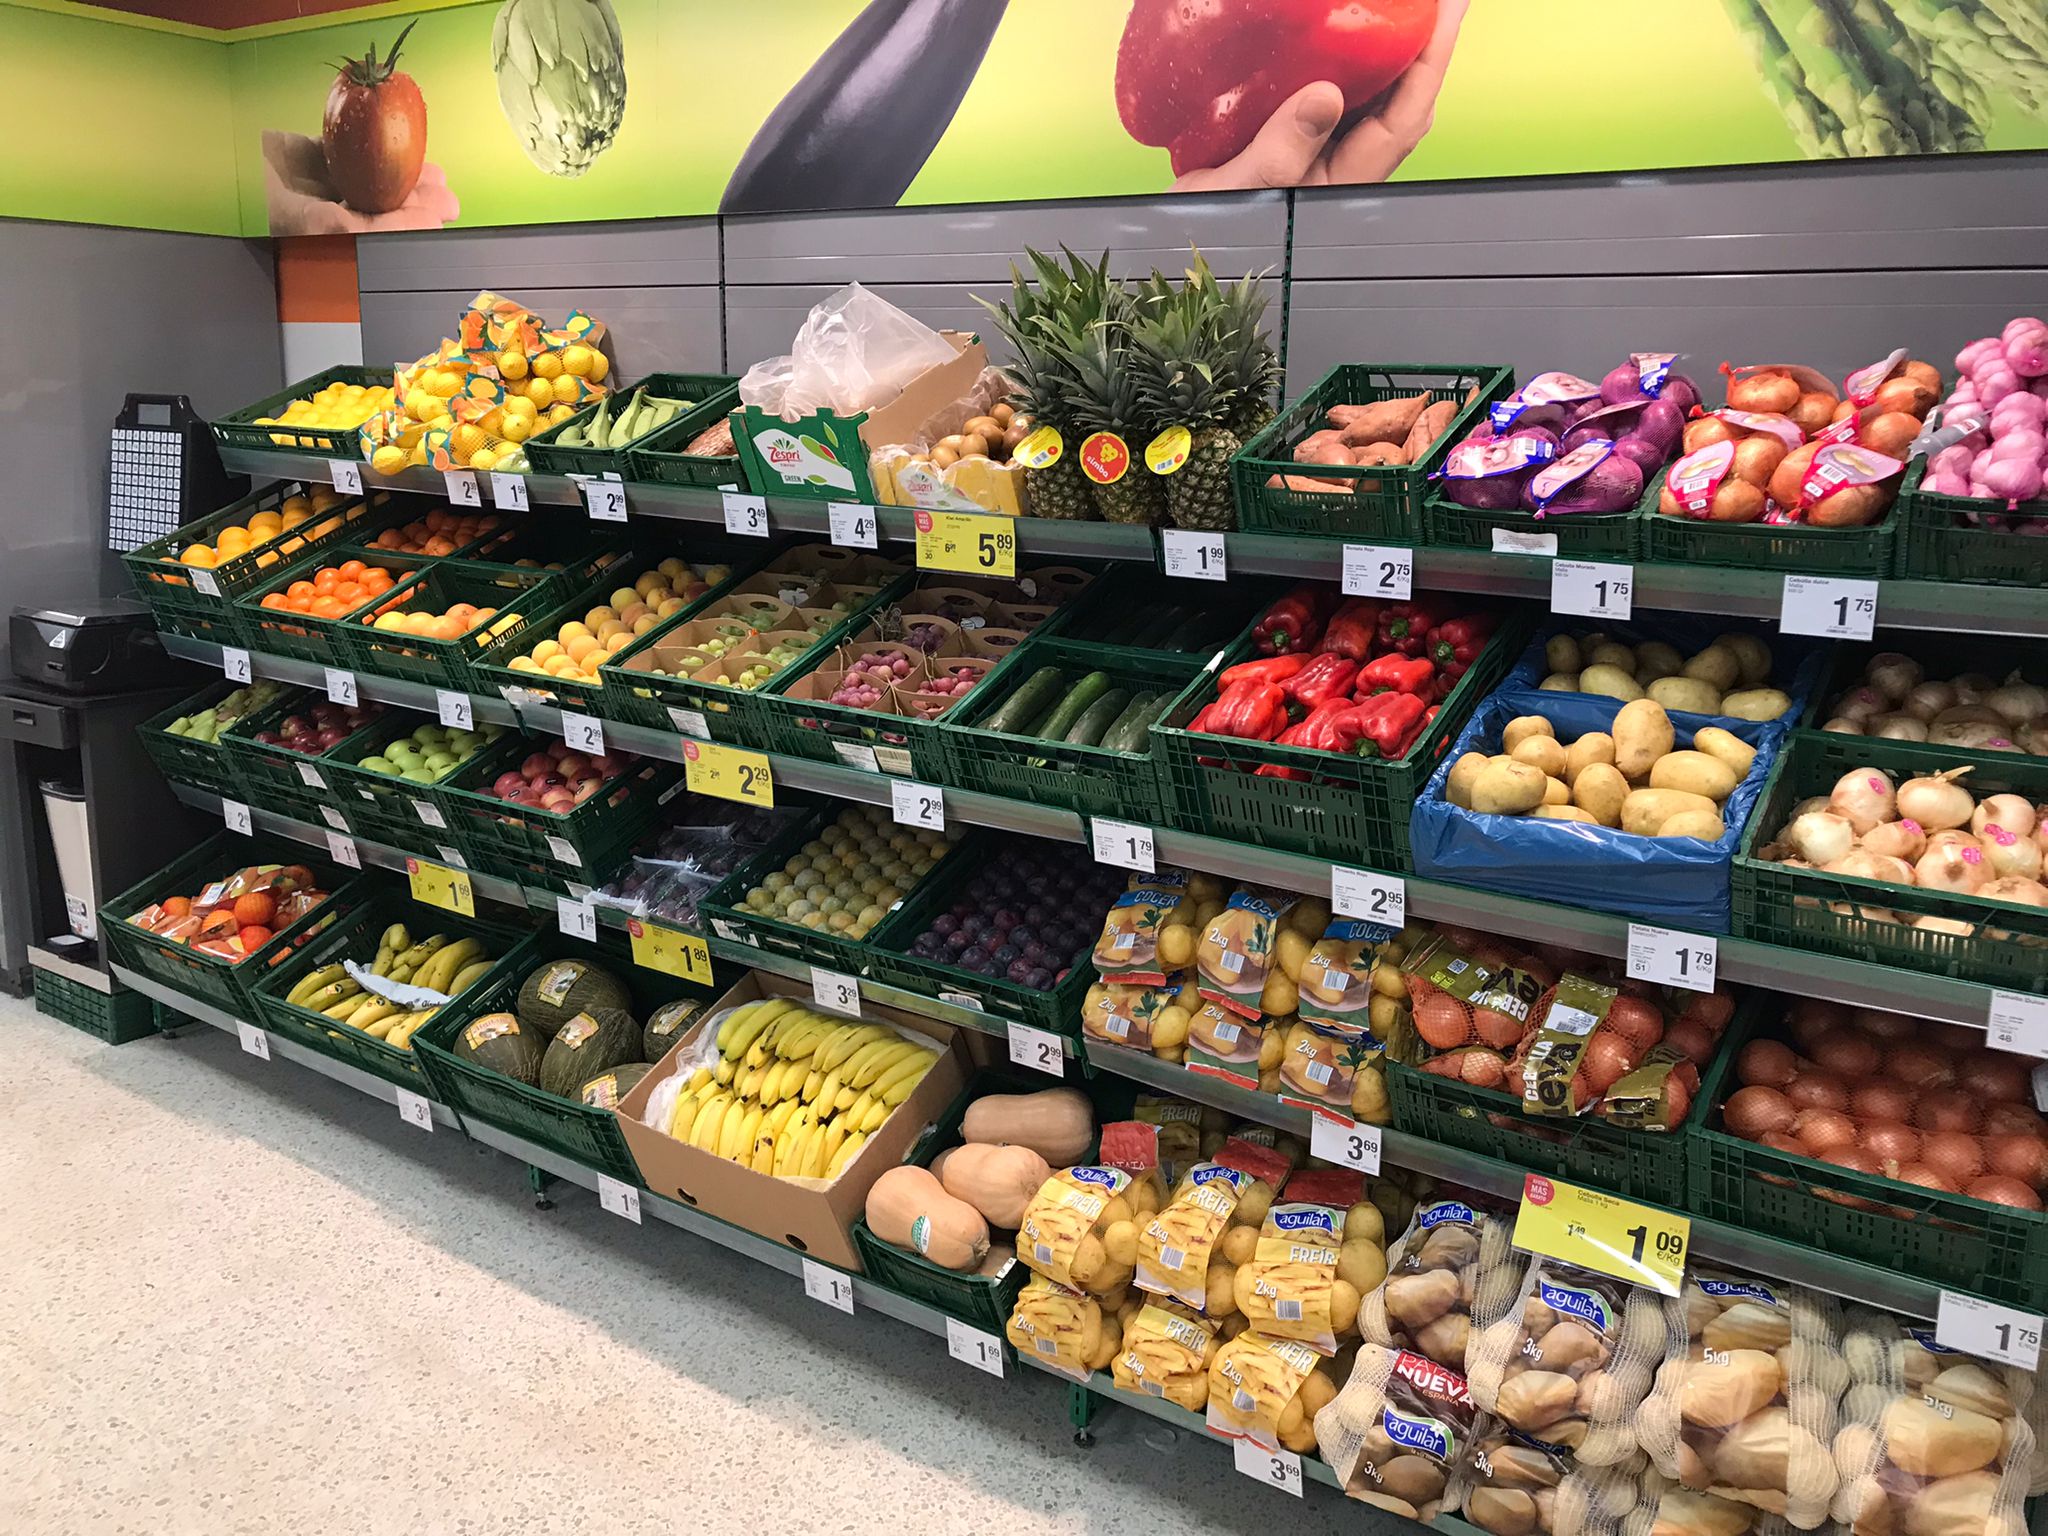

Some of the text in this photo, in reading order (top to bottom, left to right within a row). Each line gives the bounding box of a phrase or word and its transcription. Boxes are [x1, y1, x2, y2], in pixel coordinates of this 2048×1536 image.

[767, 446, 802, 462] Zespri
[1087, 456, 1109, 478] simba
[784, 475, 802, 483] GREEN
[1134, 889, 1178, 907] COCER
[1106, 925, 1121, 937] 2kg
[1208, 928, 1229, 949] 2kg
[1309, 952, 1331, 969] 2kg
[1098, 996, 1117, 1013] 2kg
[1204, 1006, 1225, 1022] 2kg
[1296, 1039, 1318, 1060] 2kg
[1522, 1040, 1554, 1102] CEBLLA
[1073, 1167, 1114, 1188] aguilar
[1196, 1170, 1237, 1186] aguilar
[1530, 1184, 1549, 1197] MAS
[1279, 1211, 1327, 1230] aguilar
[1424, 1206, 1468, 1225] aguilar
[1026, 1219, 1040, 1239] 2kg
[1148, 1222, 1169, 1243] 2kg
[1255, 1279, 1278, 1298] 2kg
[1706, 1281, 1767, 1299] aguilar
[1545, 1287, 1602, 1321] aguilar
[1015, 1313, 1034, 1335] 2kg
[1521, 1337, 1544, 1362] 3kg
[1703, 1347, 1730, 1366] 5kg
[1124, 1351, 1145, 1375] 2kg
[1221, 1358, 1242, 1385] 2kg
[1396, 1364, 1475, 1410] NUEVA
[1388, 1416, 1443, 1451] aguilar
[1363, 1460, 1384, 1483] 3kg
[1474, 1450, 1494, 1477] 3kg
